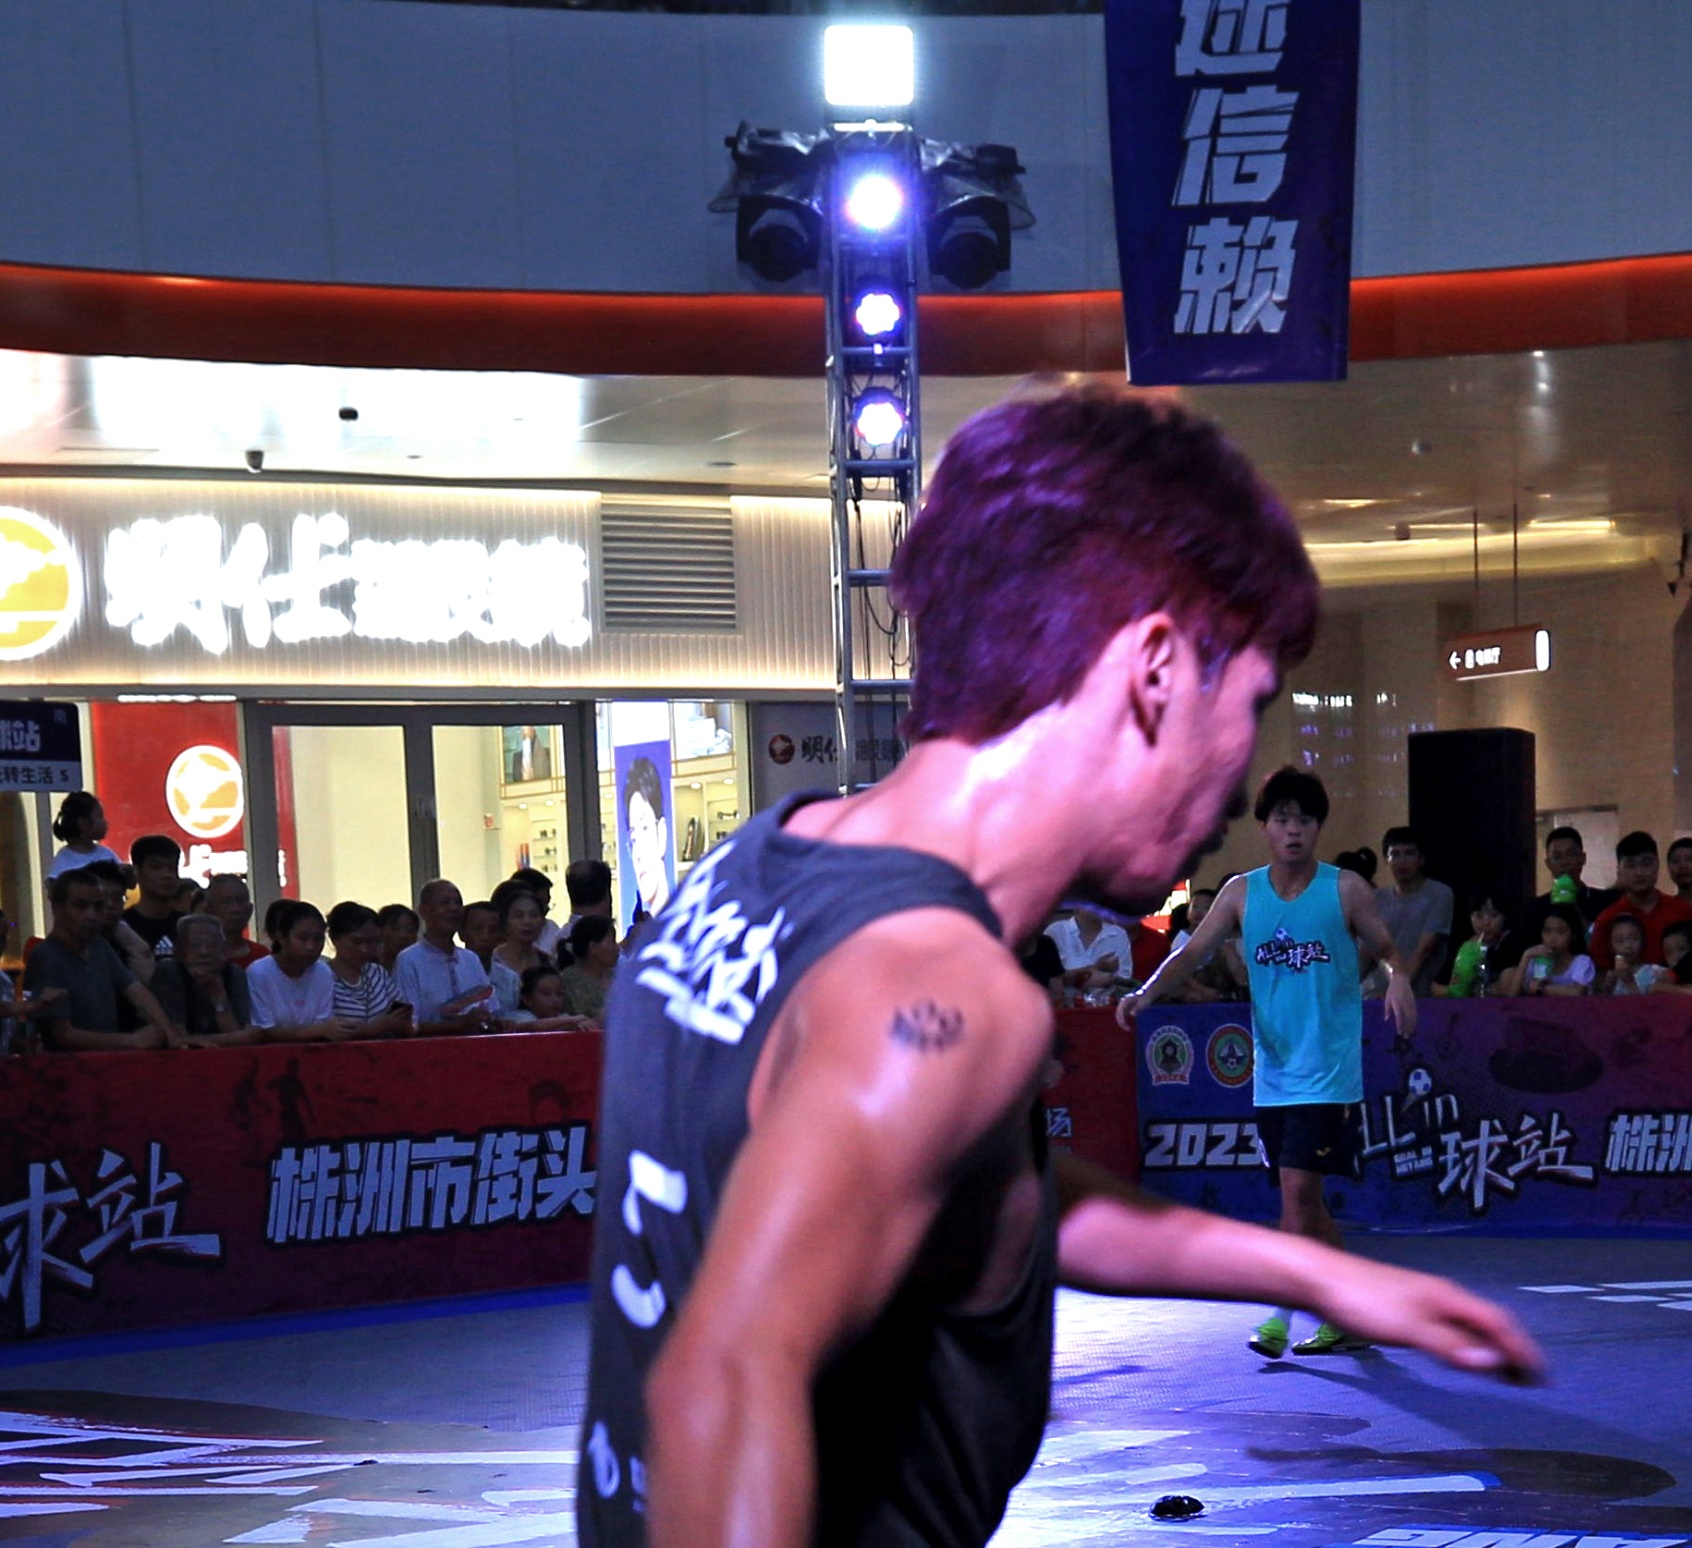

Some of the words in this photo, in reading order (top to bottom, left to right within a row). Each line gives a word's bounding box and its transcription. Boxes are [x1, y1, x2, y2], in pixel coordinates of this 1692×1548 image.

[0, 766, 53, 785] 转生活
[1346, 1095, 1416, 1175] LL
[1437, 1112, 1594, 1209] 球站
[266, 1125, 597, 1244] 株洲市街头
